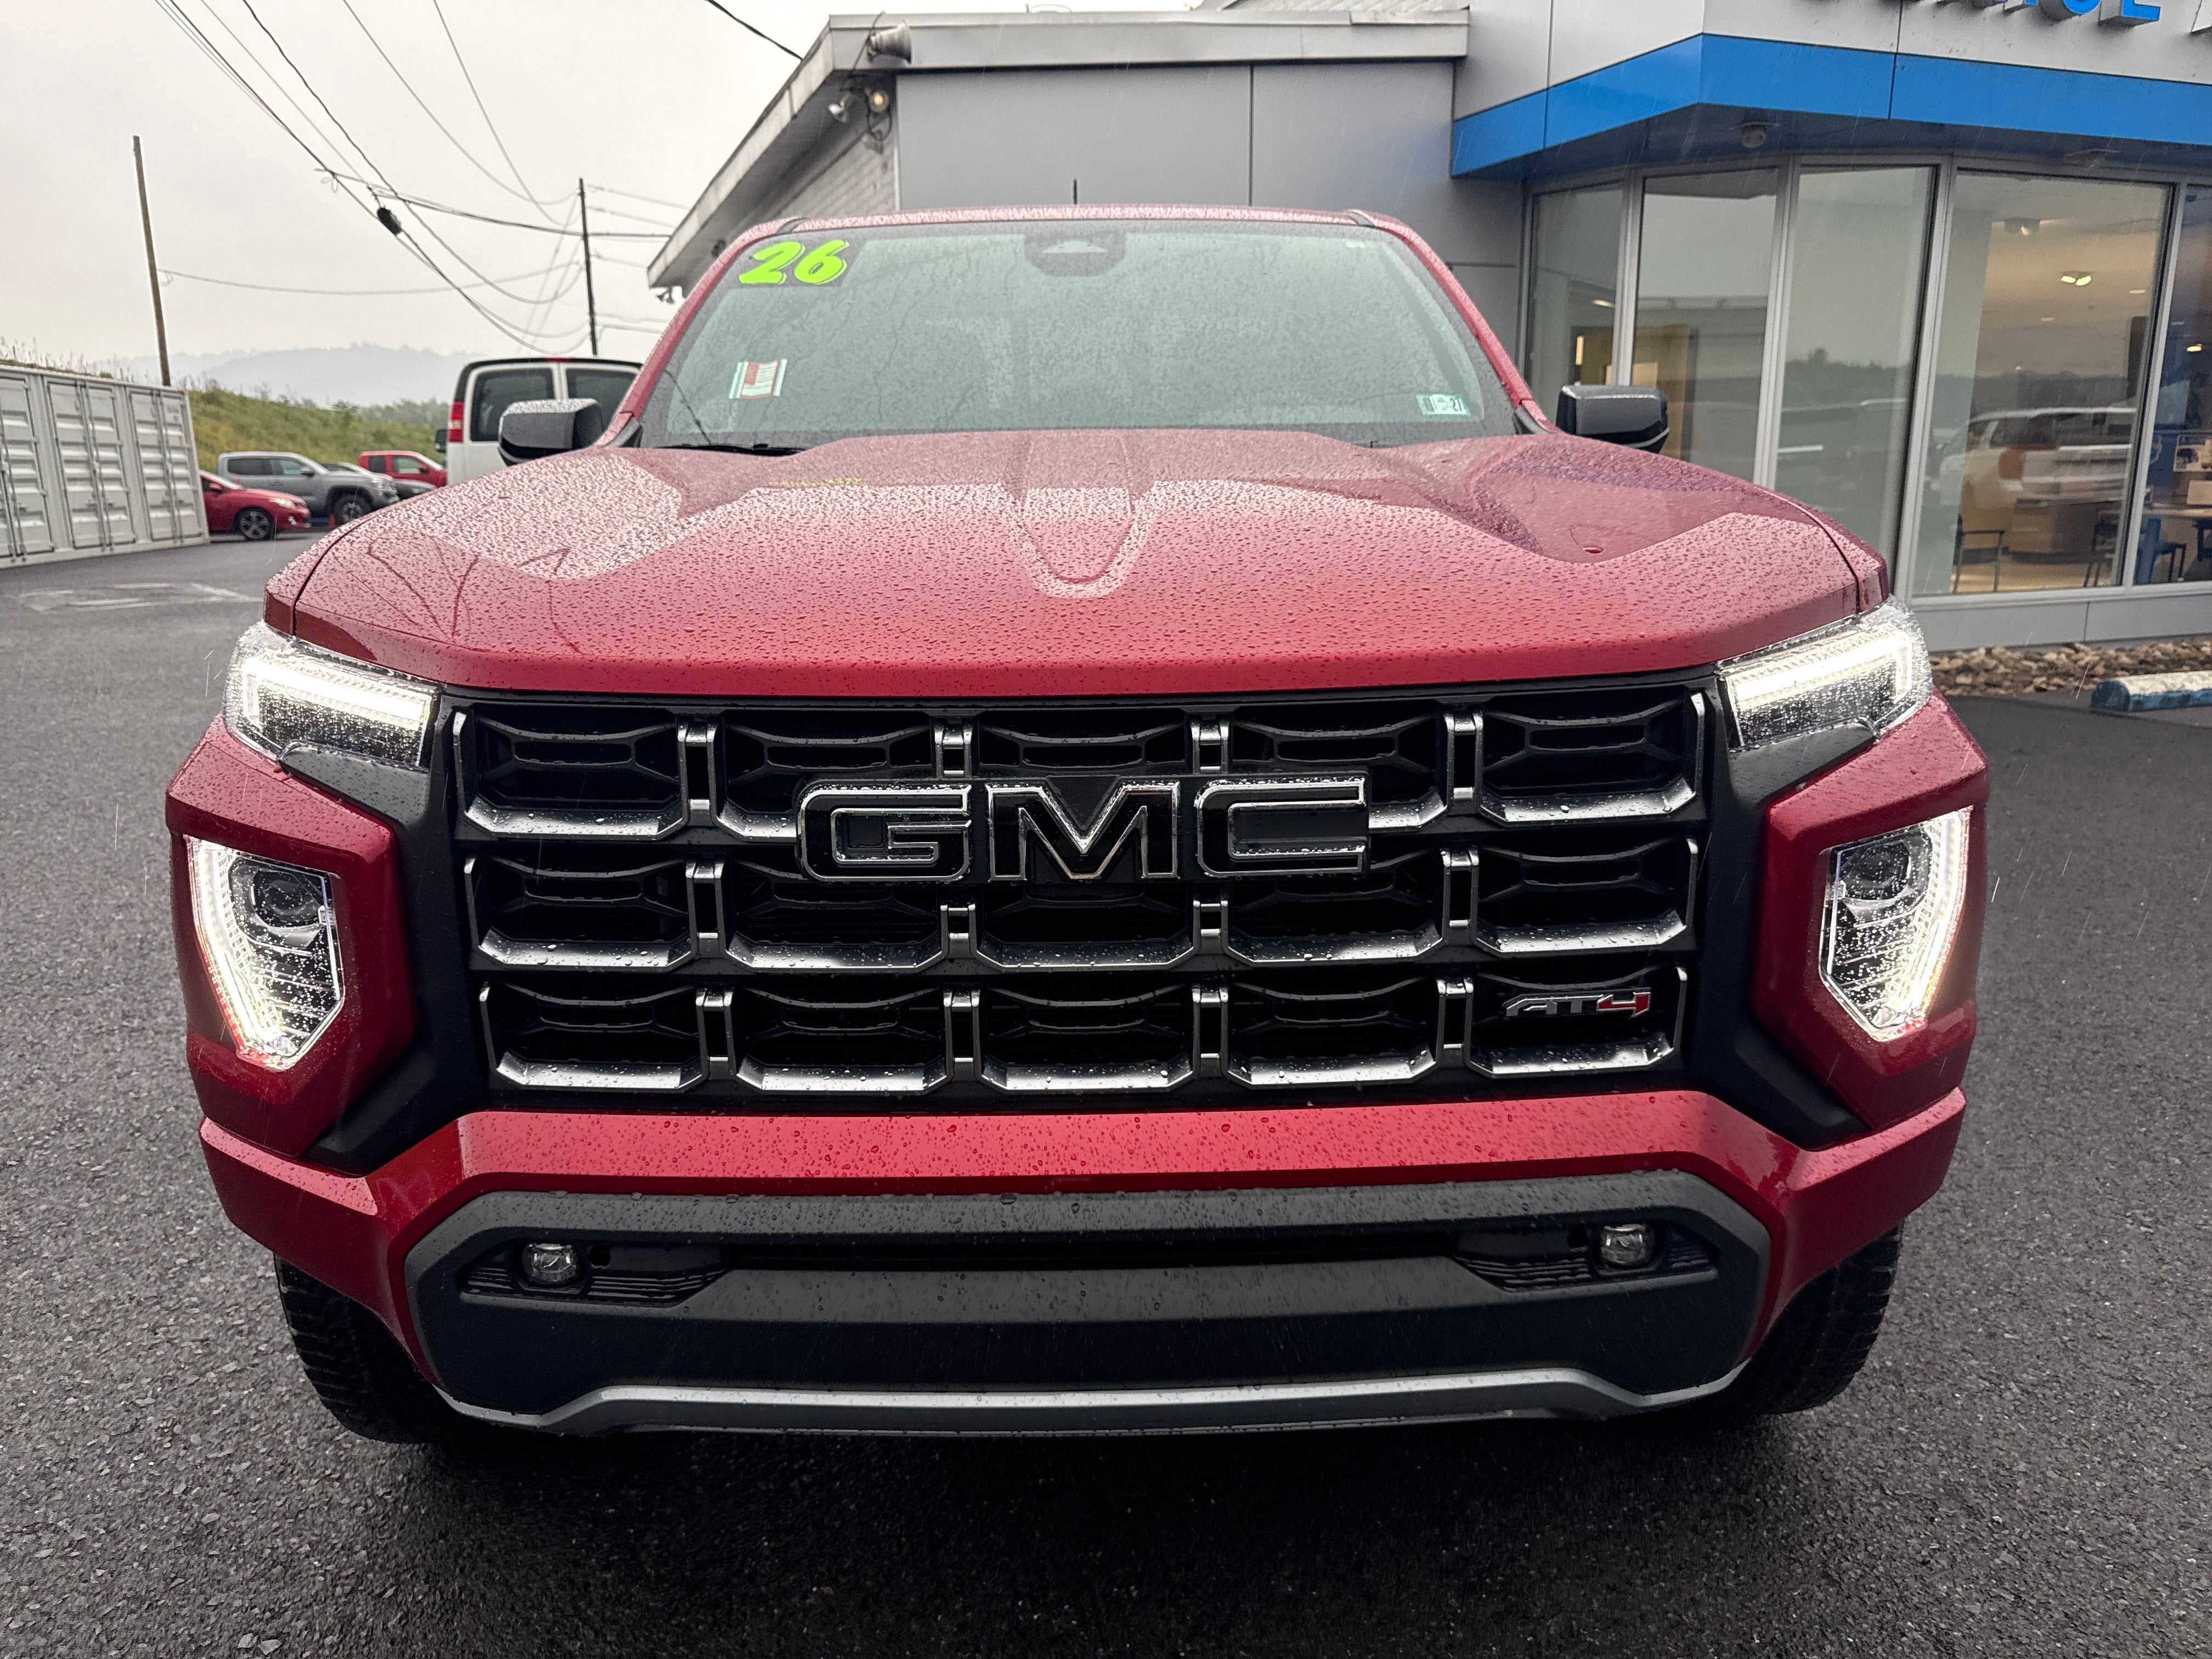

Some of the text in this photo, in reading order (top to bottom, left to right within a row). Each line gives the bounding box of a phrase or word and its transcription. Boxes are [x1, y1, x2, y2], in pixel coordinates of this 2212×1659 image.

[738, 239, 850, 285] 26
[799, 776, 1368, 883] GMC
[1504, 990, 1652, 1018] AT4
